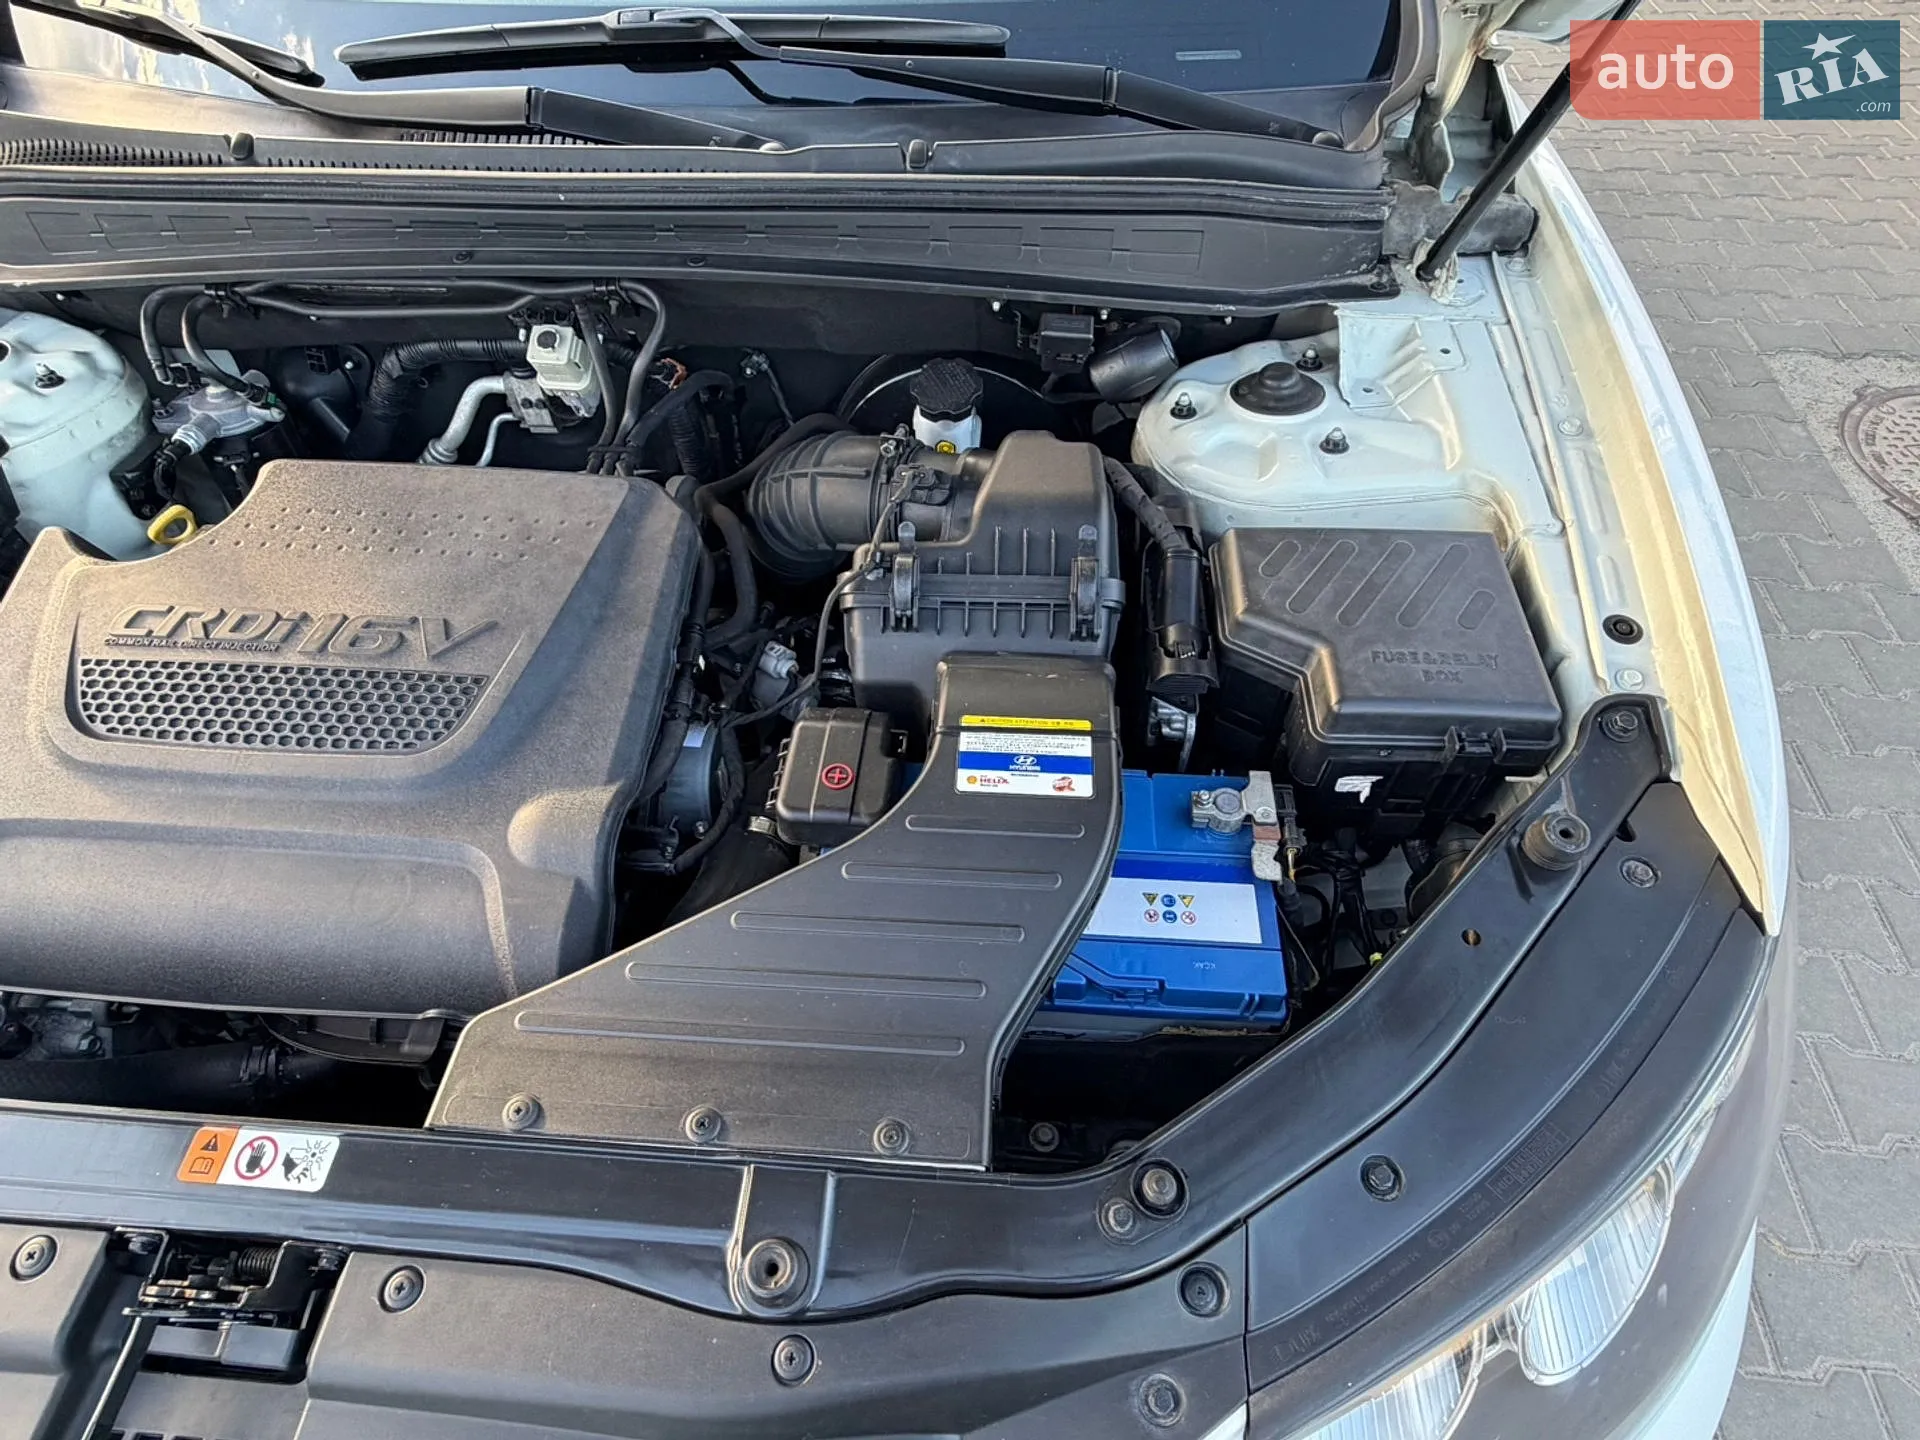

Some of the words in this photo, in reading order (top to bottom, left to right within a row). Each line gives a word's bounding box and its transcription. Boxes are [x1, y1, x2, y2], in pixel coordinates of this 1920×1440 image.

[108, 604, 309, 643] CRDi
[103, 636, 152, 648] COMMON
[219, 641, 280, 652] INJECTION
[1420, 669, 1463, 684] BOX
